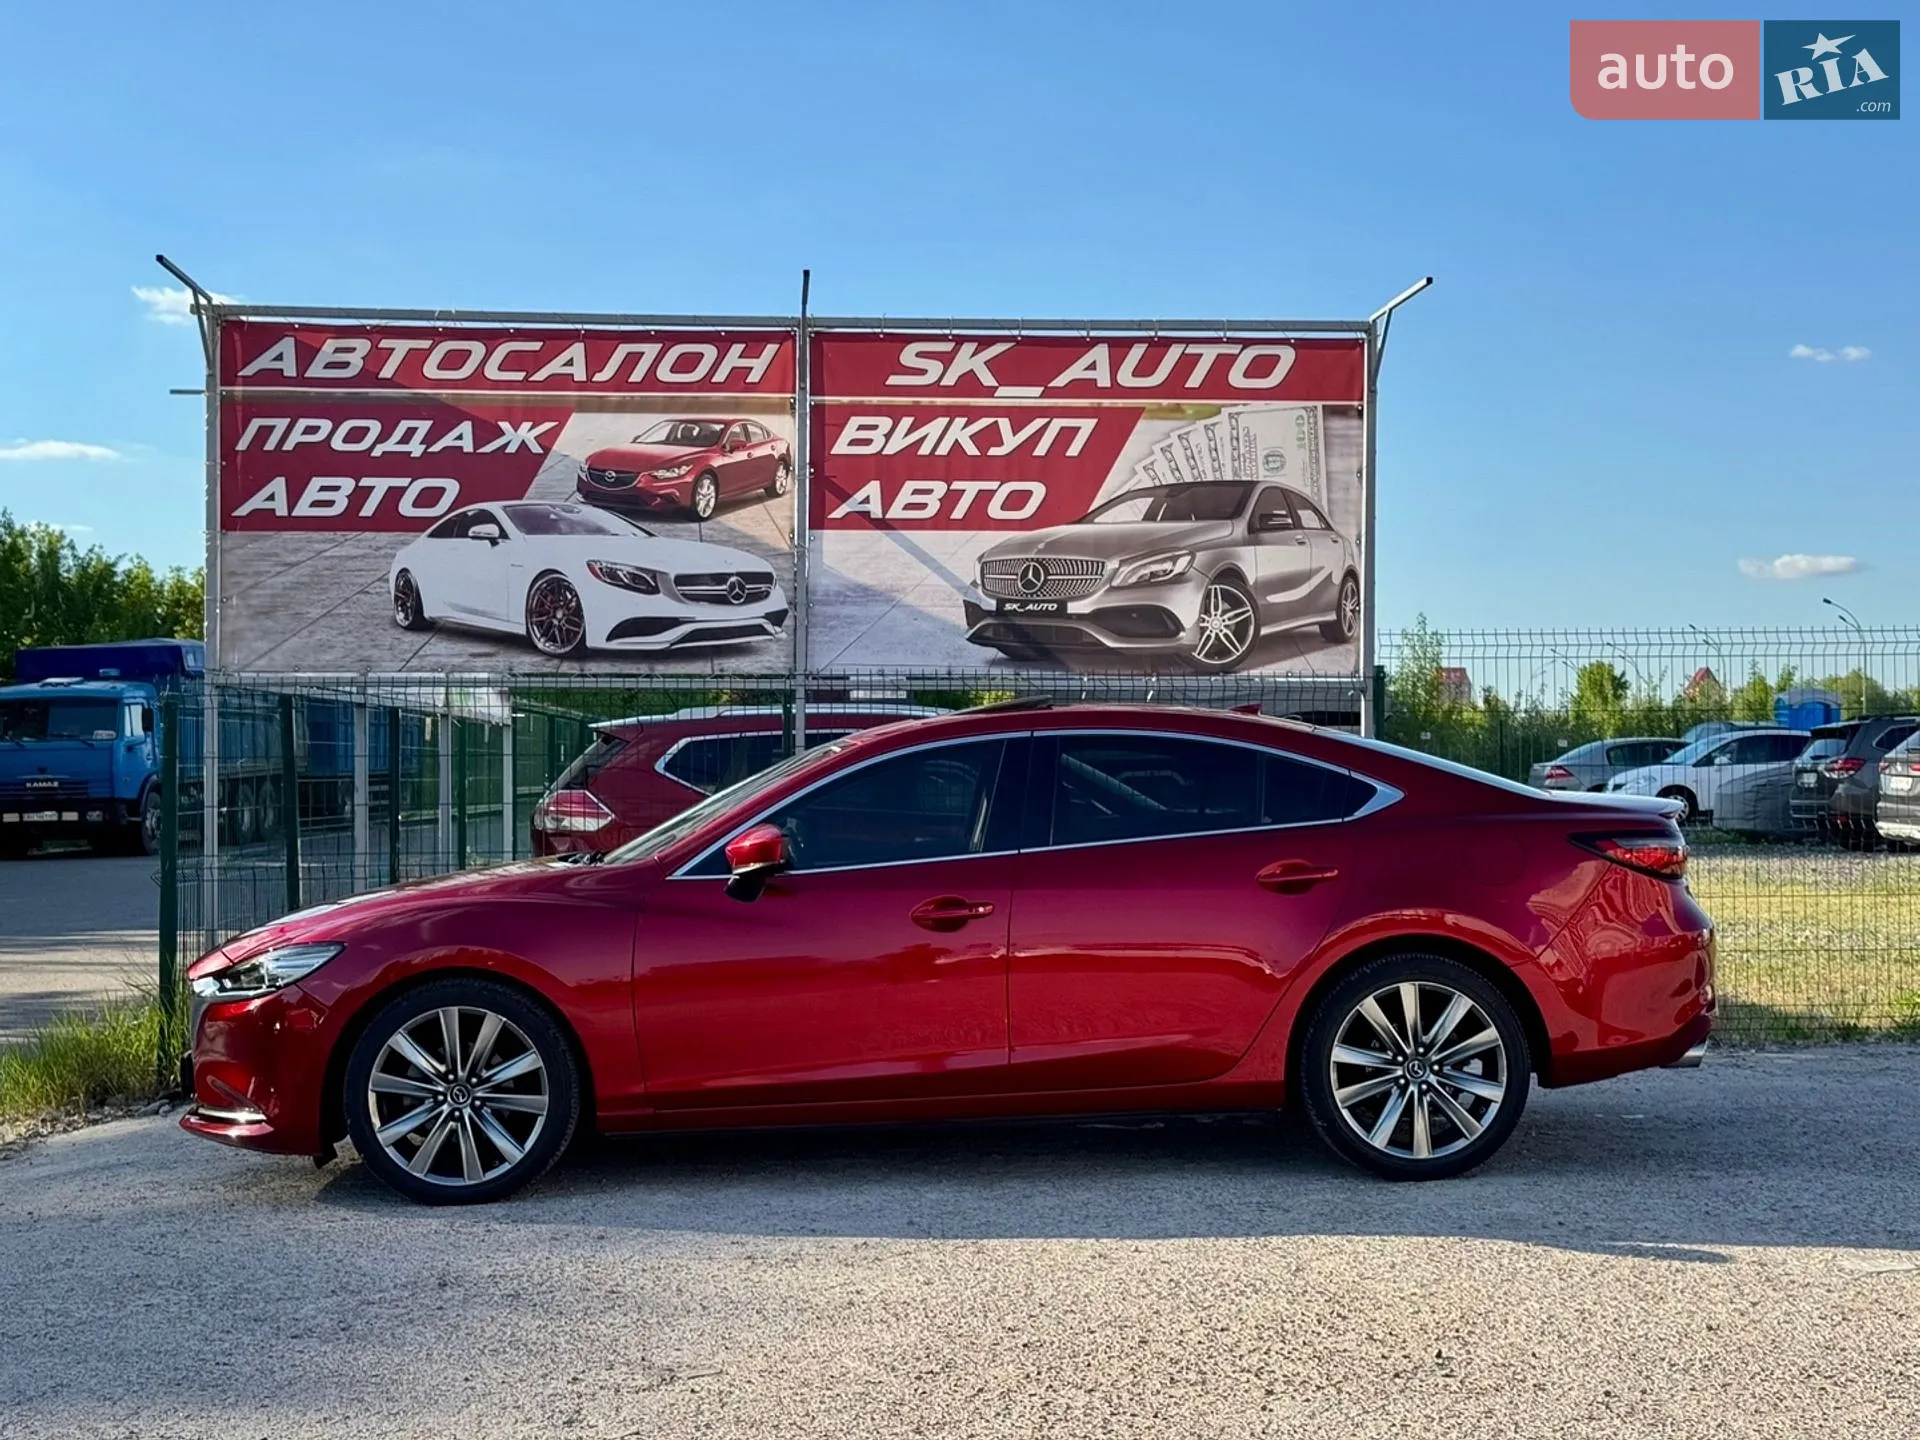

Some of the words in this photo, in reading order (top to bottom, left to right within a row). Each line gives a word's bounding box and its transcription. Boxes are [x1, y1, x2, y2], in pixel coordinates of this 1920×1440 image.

[237, 336, 780, 383] АВТОСАЛОН
[885, 341, 1296, 398] SK_AUTO
[235, 417, 559, 458] ПРОДАЖ
[830, 415, 1099, 457] ВИКУП
[231, 476, 461, 518] АВТО
[826, 479, 1048, 520] АВТО
[1003, 602, 1059, 612] SK_AUTO
